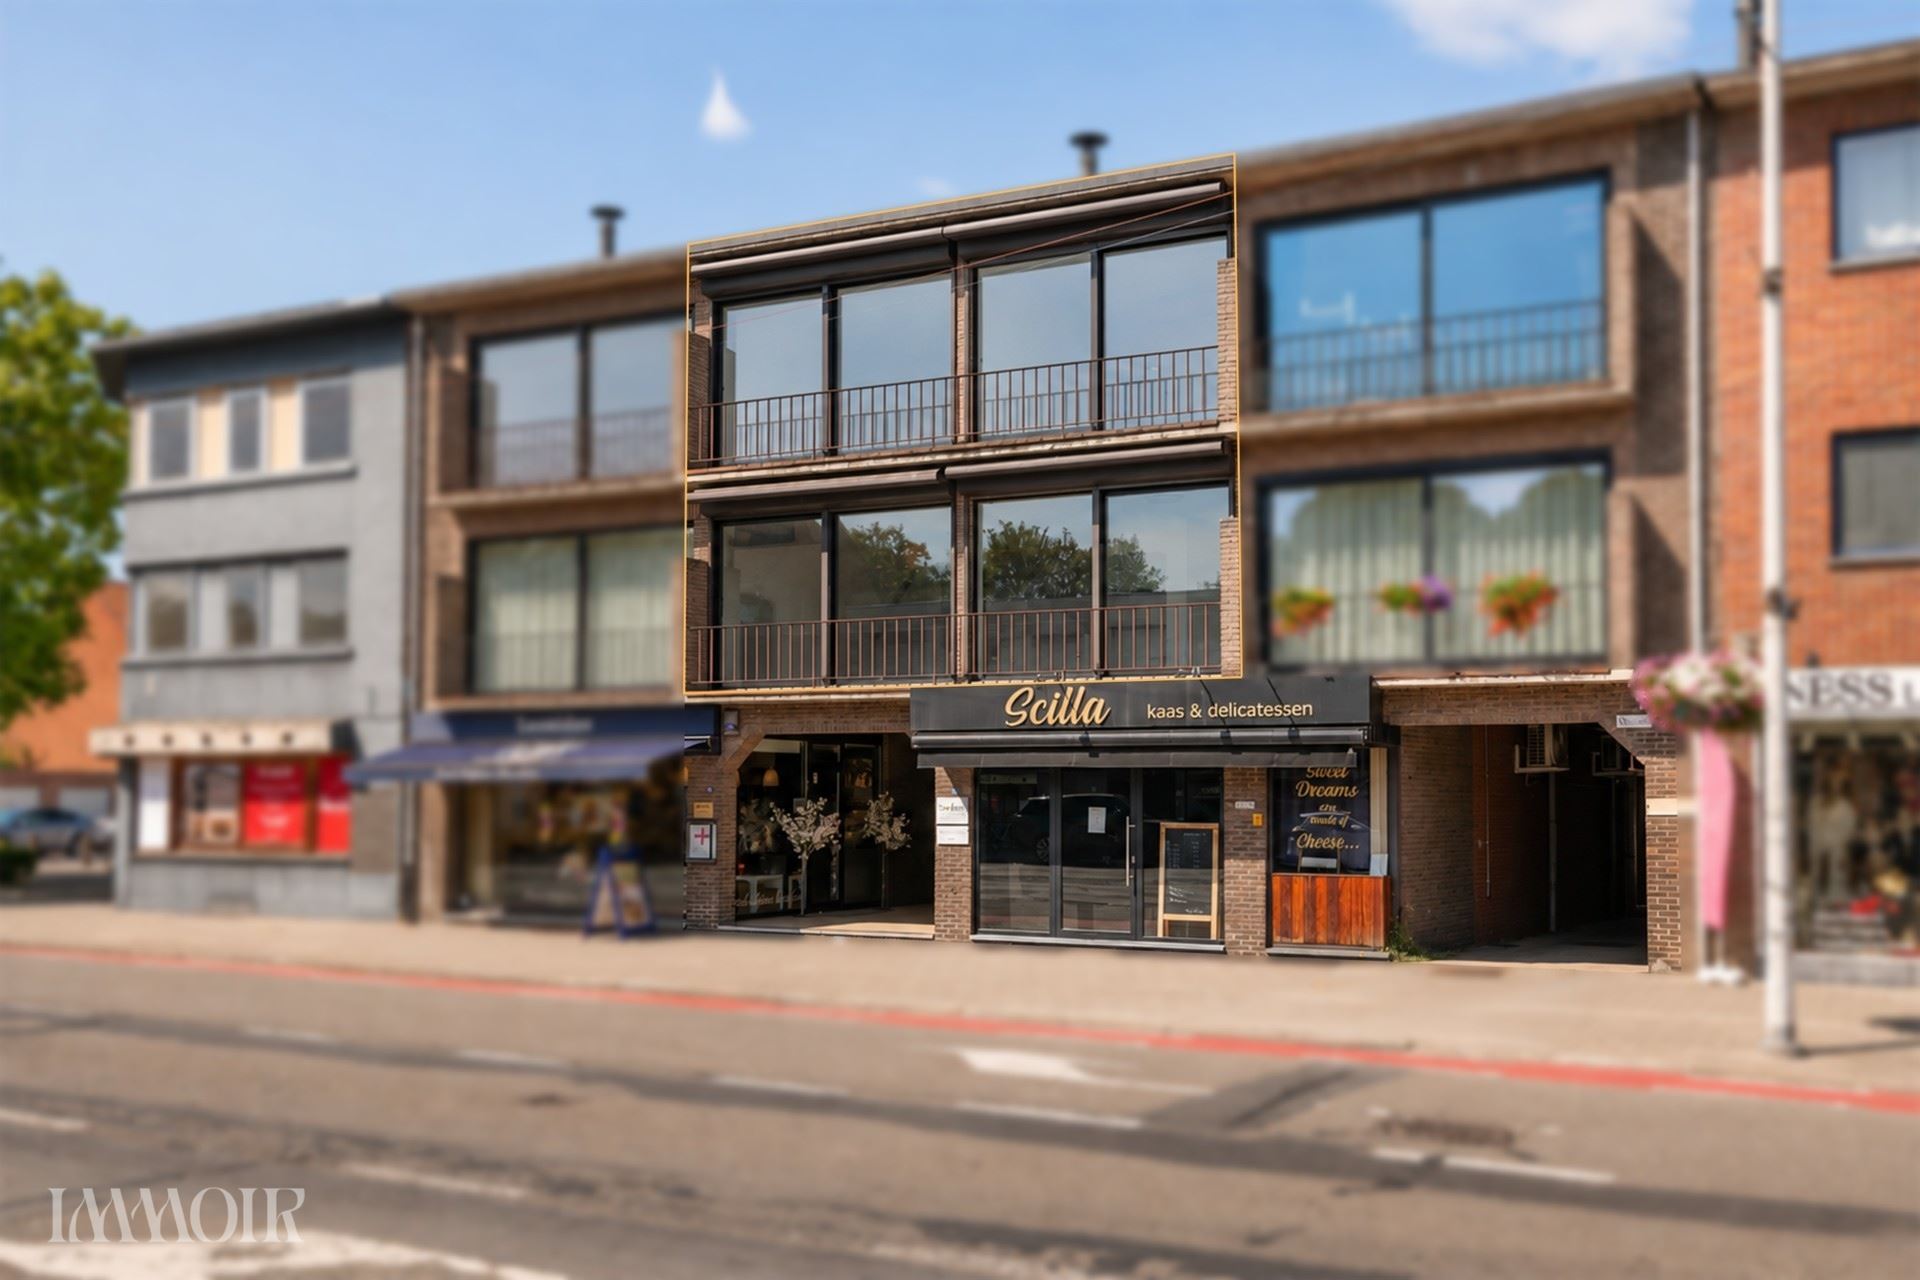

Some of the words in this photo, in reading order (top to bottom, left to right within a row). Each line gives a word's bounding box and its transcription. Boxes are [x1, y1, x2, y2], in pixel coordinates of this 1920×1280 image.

[1005, 687, 1111, 727] Scilla
[1147, 703, 1185, 719] kaas
[1190, 704, 1203, 719] &
[1208, 700, 1313, 719] delicatessen
[1306, 767, 1349, 778] Sweet
[1296, 781, 1359, 797] Dreams
[1297, 833, 1360, 849] Cheese...
